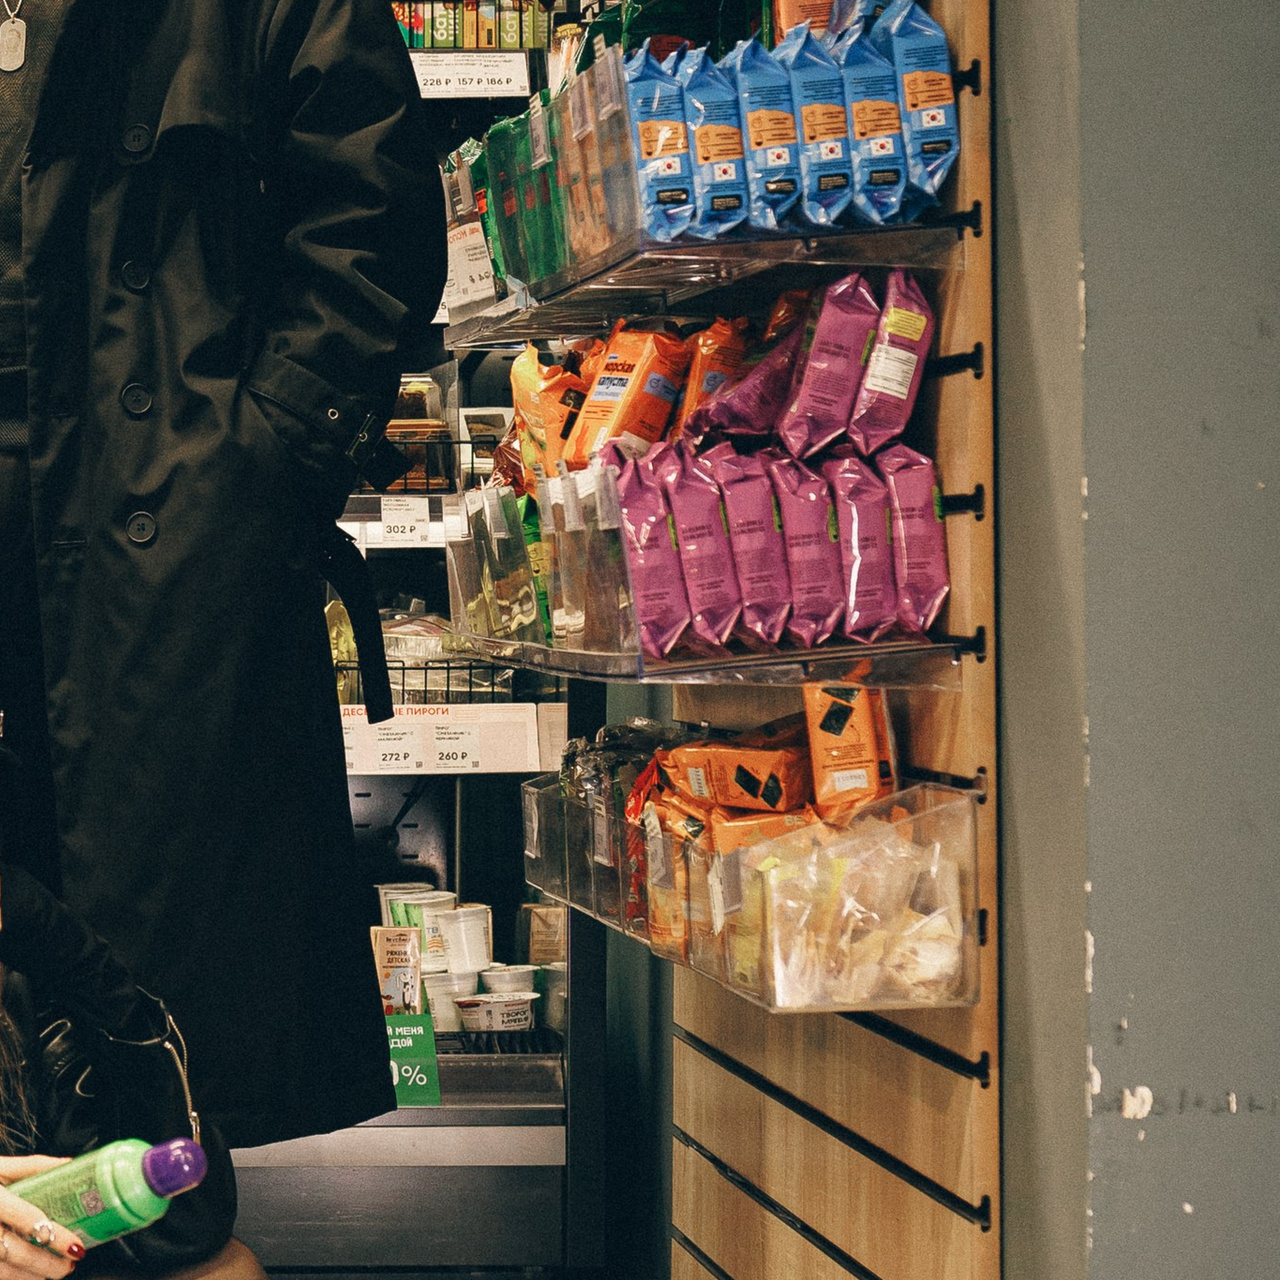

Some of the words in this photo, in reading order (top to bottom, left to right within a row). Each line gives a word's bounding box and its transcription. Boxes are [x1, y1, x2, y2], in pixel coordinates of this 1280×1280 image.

[422, 78, 442, 86] 228
[457, 78, 474, 86] 157
[486, 77, 503, 86] 186
[386, 525, 406, 533] 302
[407, 707, 449, 716] ПИРОГИ
[381, 753, 400, 761] 272
[438, 752, 458, 761] 260
[395, 1026, 424, 1035] МЕНЯ
